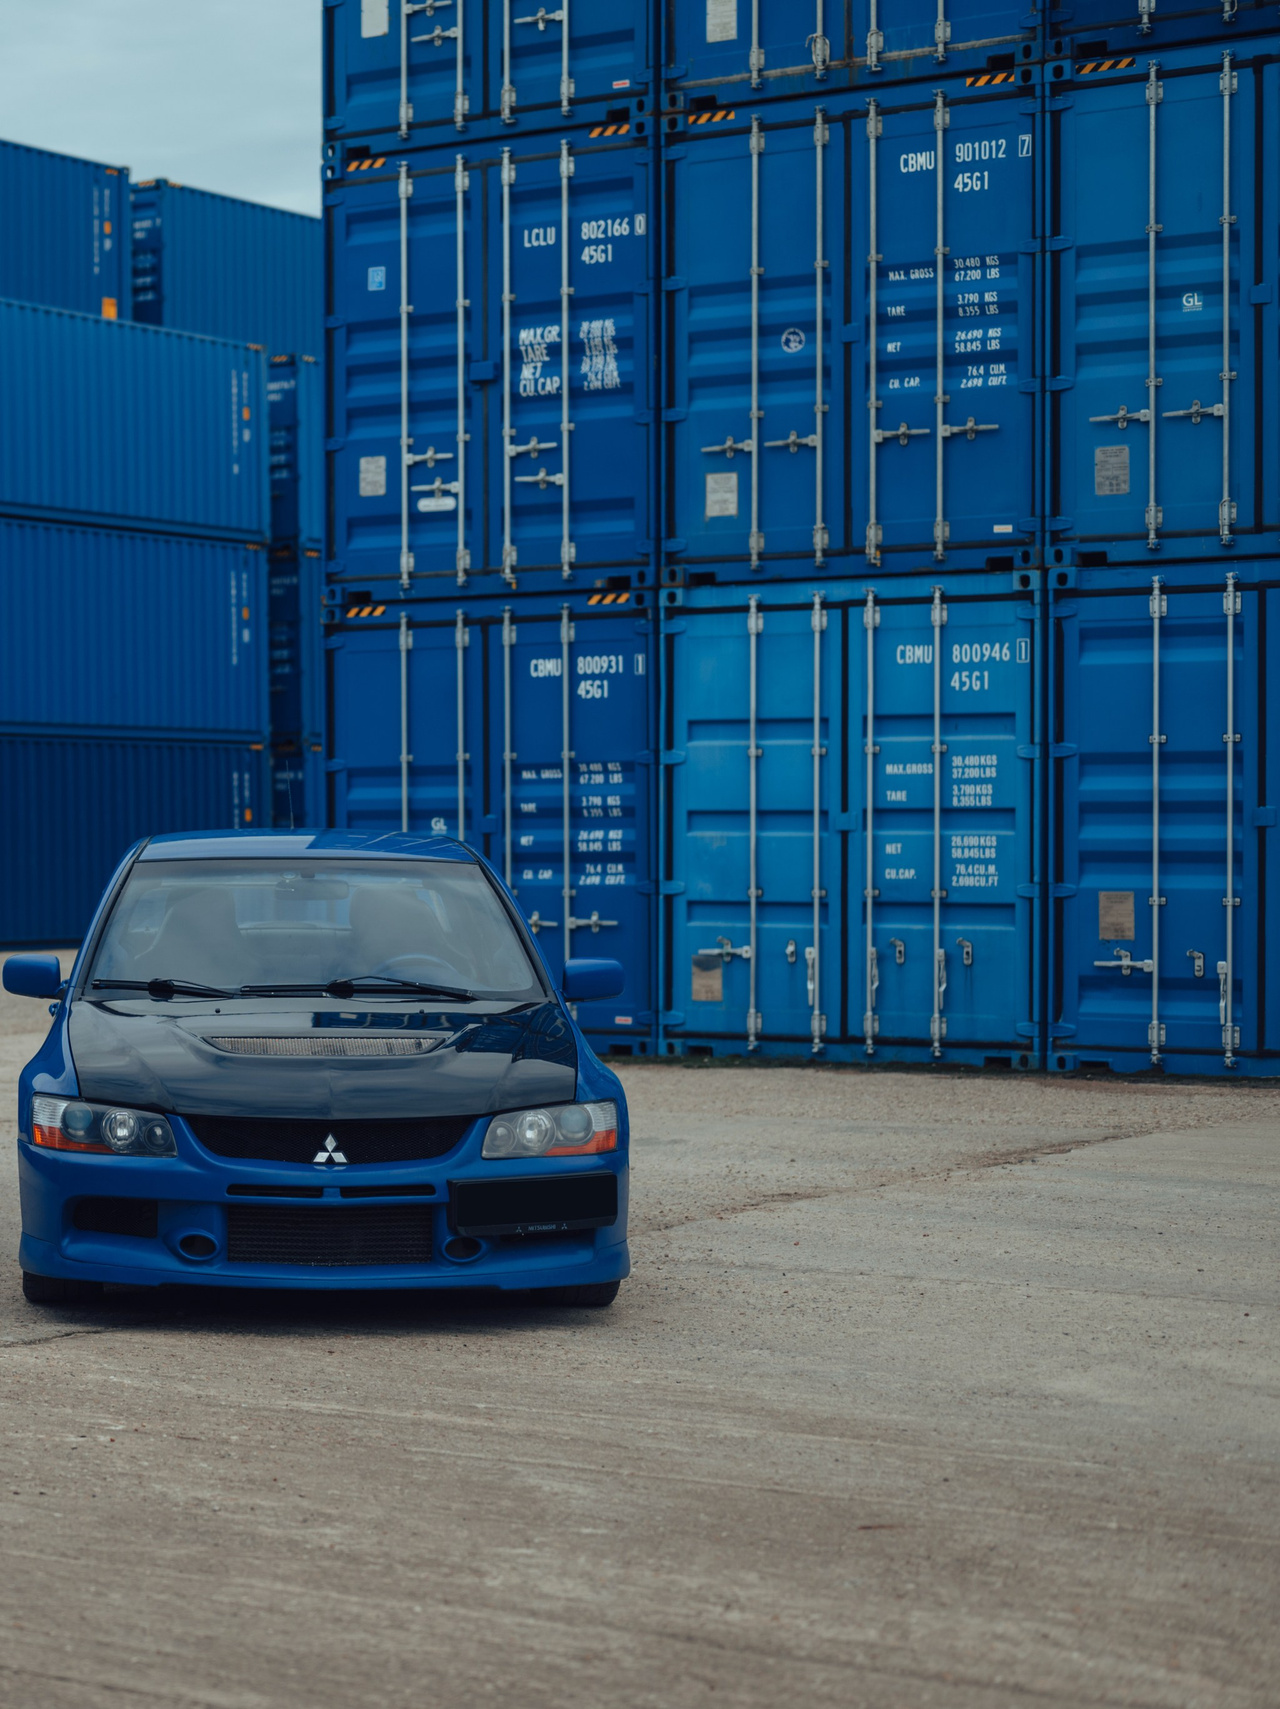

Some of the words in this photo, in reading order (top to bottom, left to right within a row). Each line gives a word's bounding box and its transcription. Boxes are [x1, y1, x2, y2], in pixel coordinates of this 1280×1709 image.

[900, 150, 935, 173] CBMU
[955, 138, 1007, 163] 901012
[1020, 135, 1031, 156] 7
[954, 170, 989, 193] 45G1
[523, 226, 556, 248] LCLU
[581, 217, 630, 240] 802166
[635, 214, 645, 235] 0
[581, 243, 613, 265] 45G1
[986, 255, 1000, 266] KGS
[910, 268, 934, 280] GROSS
[986, 267, 1000, 279] LBS
[984, 291, 998, 303] KGS
[1182, 292, 1202, 306] GL
[887, 305, 906, 317] TARE
[985, 303, 999, 315] LBS
[886, 341, 901, 353] NET
[986, 339, 1000, 351] LBS
[520, 343, 551, 363] TARE
[520, 361, 543, 379] NET
[896, 644, 933, 665] CBMU
[952, 641, 1010, 664] 800946
[530, 657, 562, 678] CBMU
[577, 654, 623, 675] 800931
[950, 670, 989, 692] 45G1
[577, 679, 609, 699] 45G1
[886, 790, 907, 802] TARE
[885, 842, 902, 855] NET
